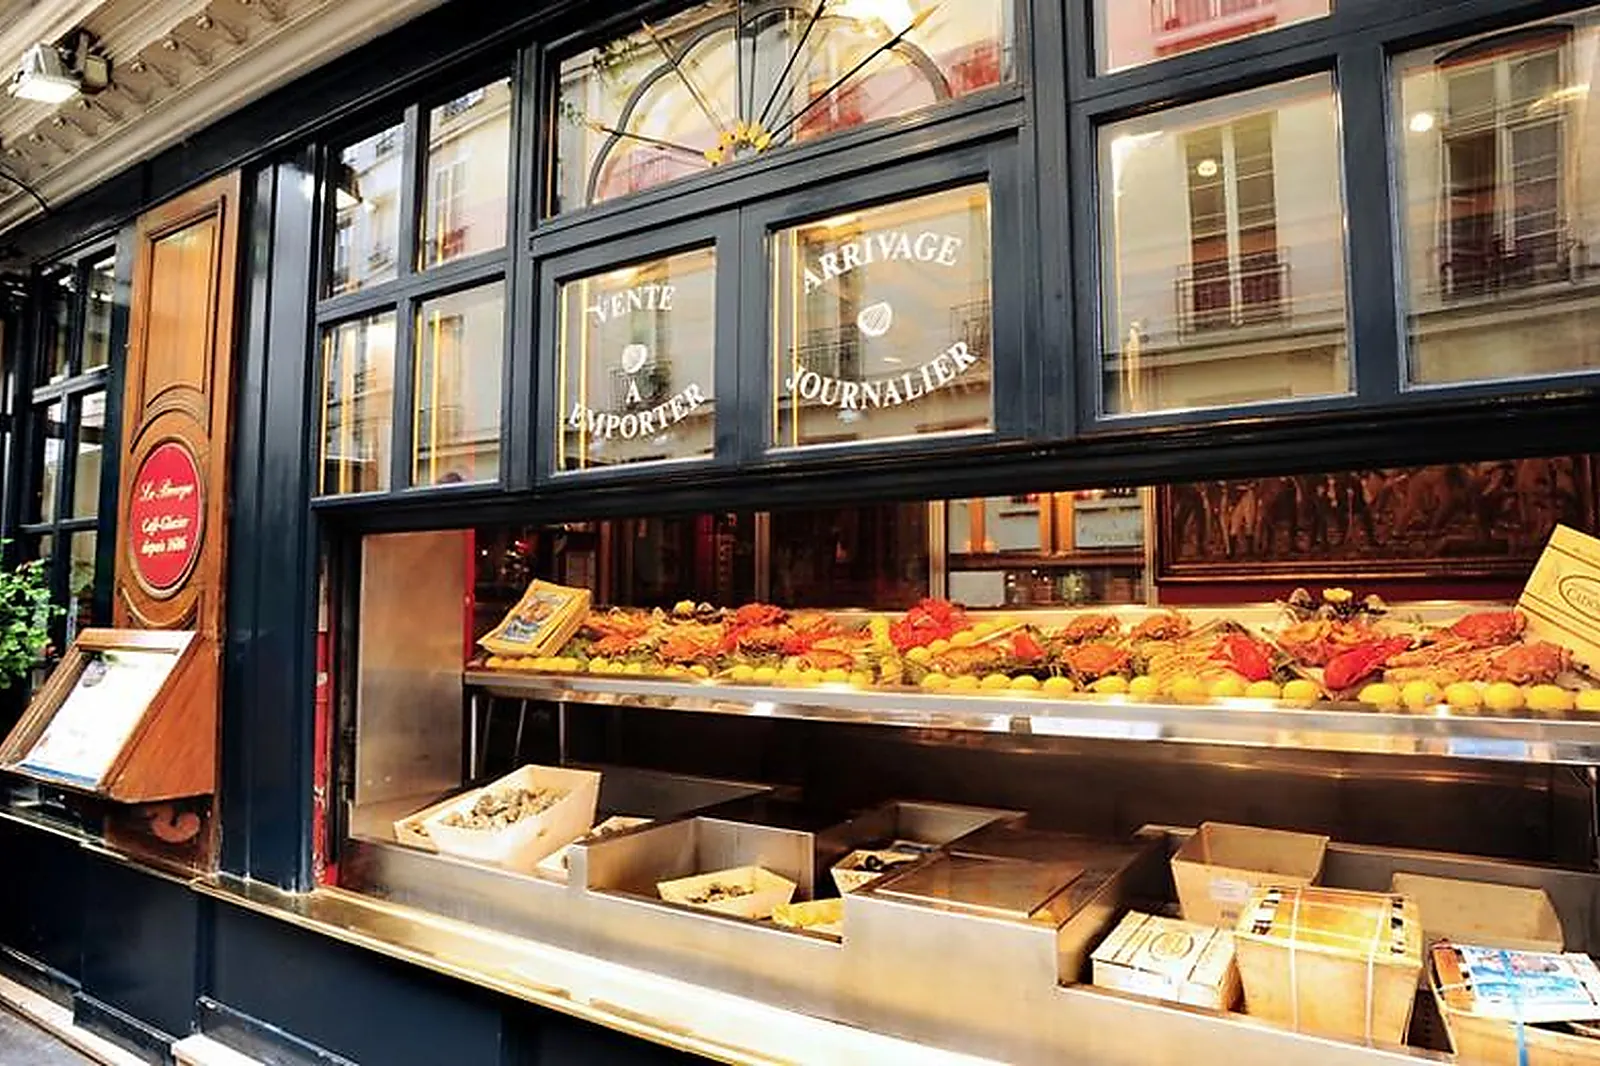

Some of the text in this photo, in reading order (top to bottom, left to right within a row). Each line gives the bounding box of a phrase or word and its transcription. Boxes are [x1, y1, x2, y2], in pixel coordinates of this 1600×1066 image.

[803, 231, 961, 294] ARRIVAGE
[588, 284, 676, 324] VENTE
[786, 341, 977, 410] JOURNALIER
[569, 383, 705, 439] EMPORTER
